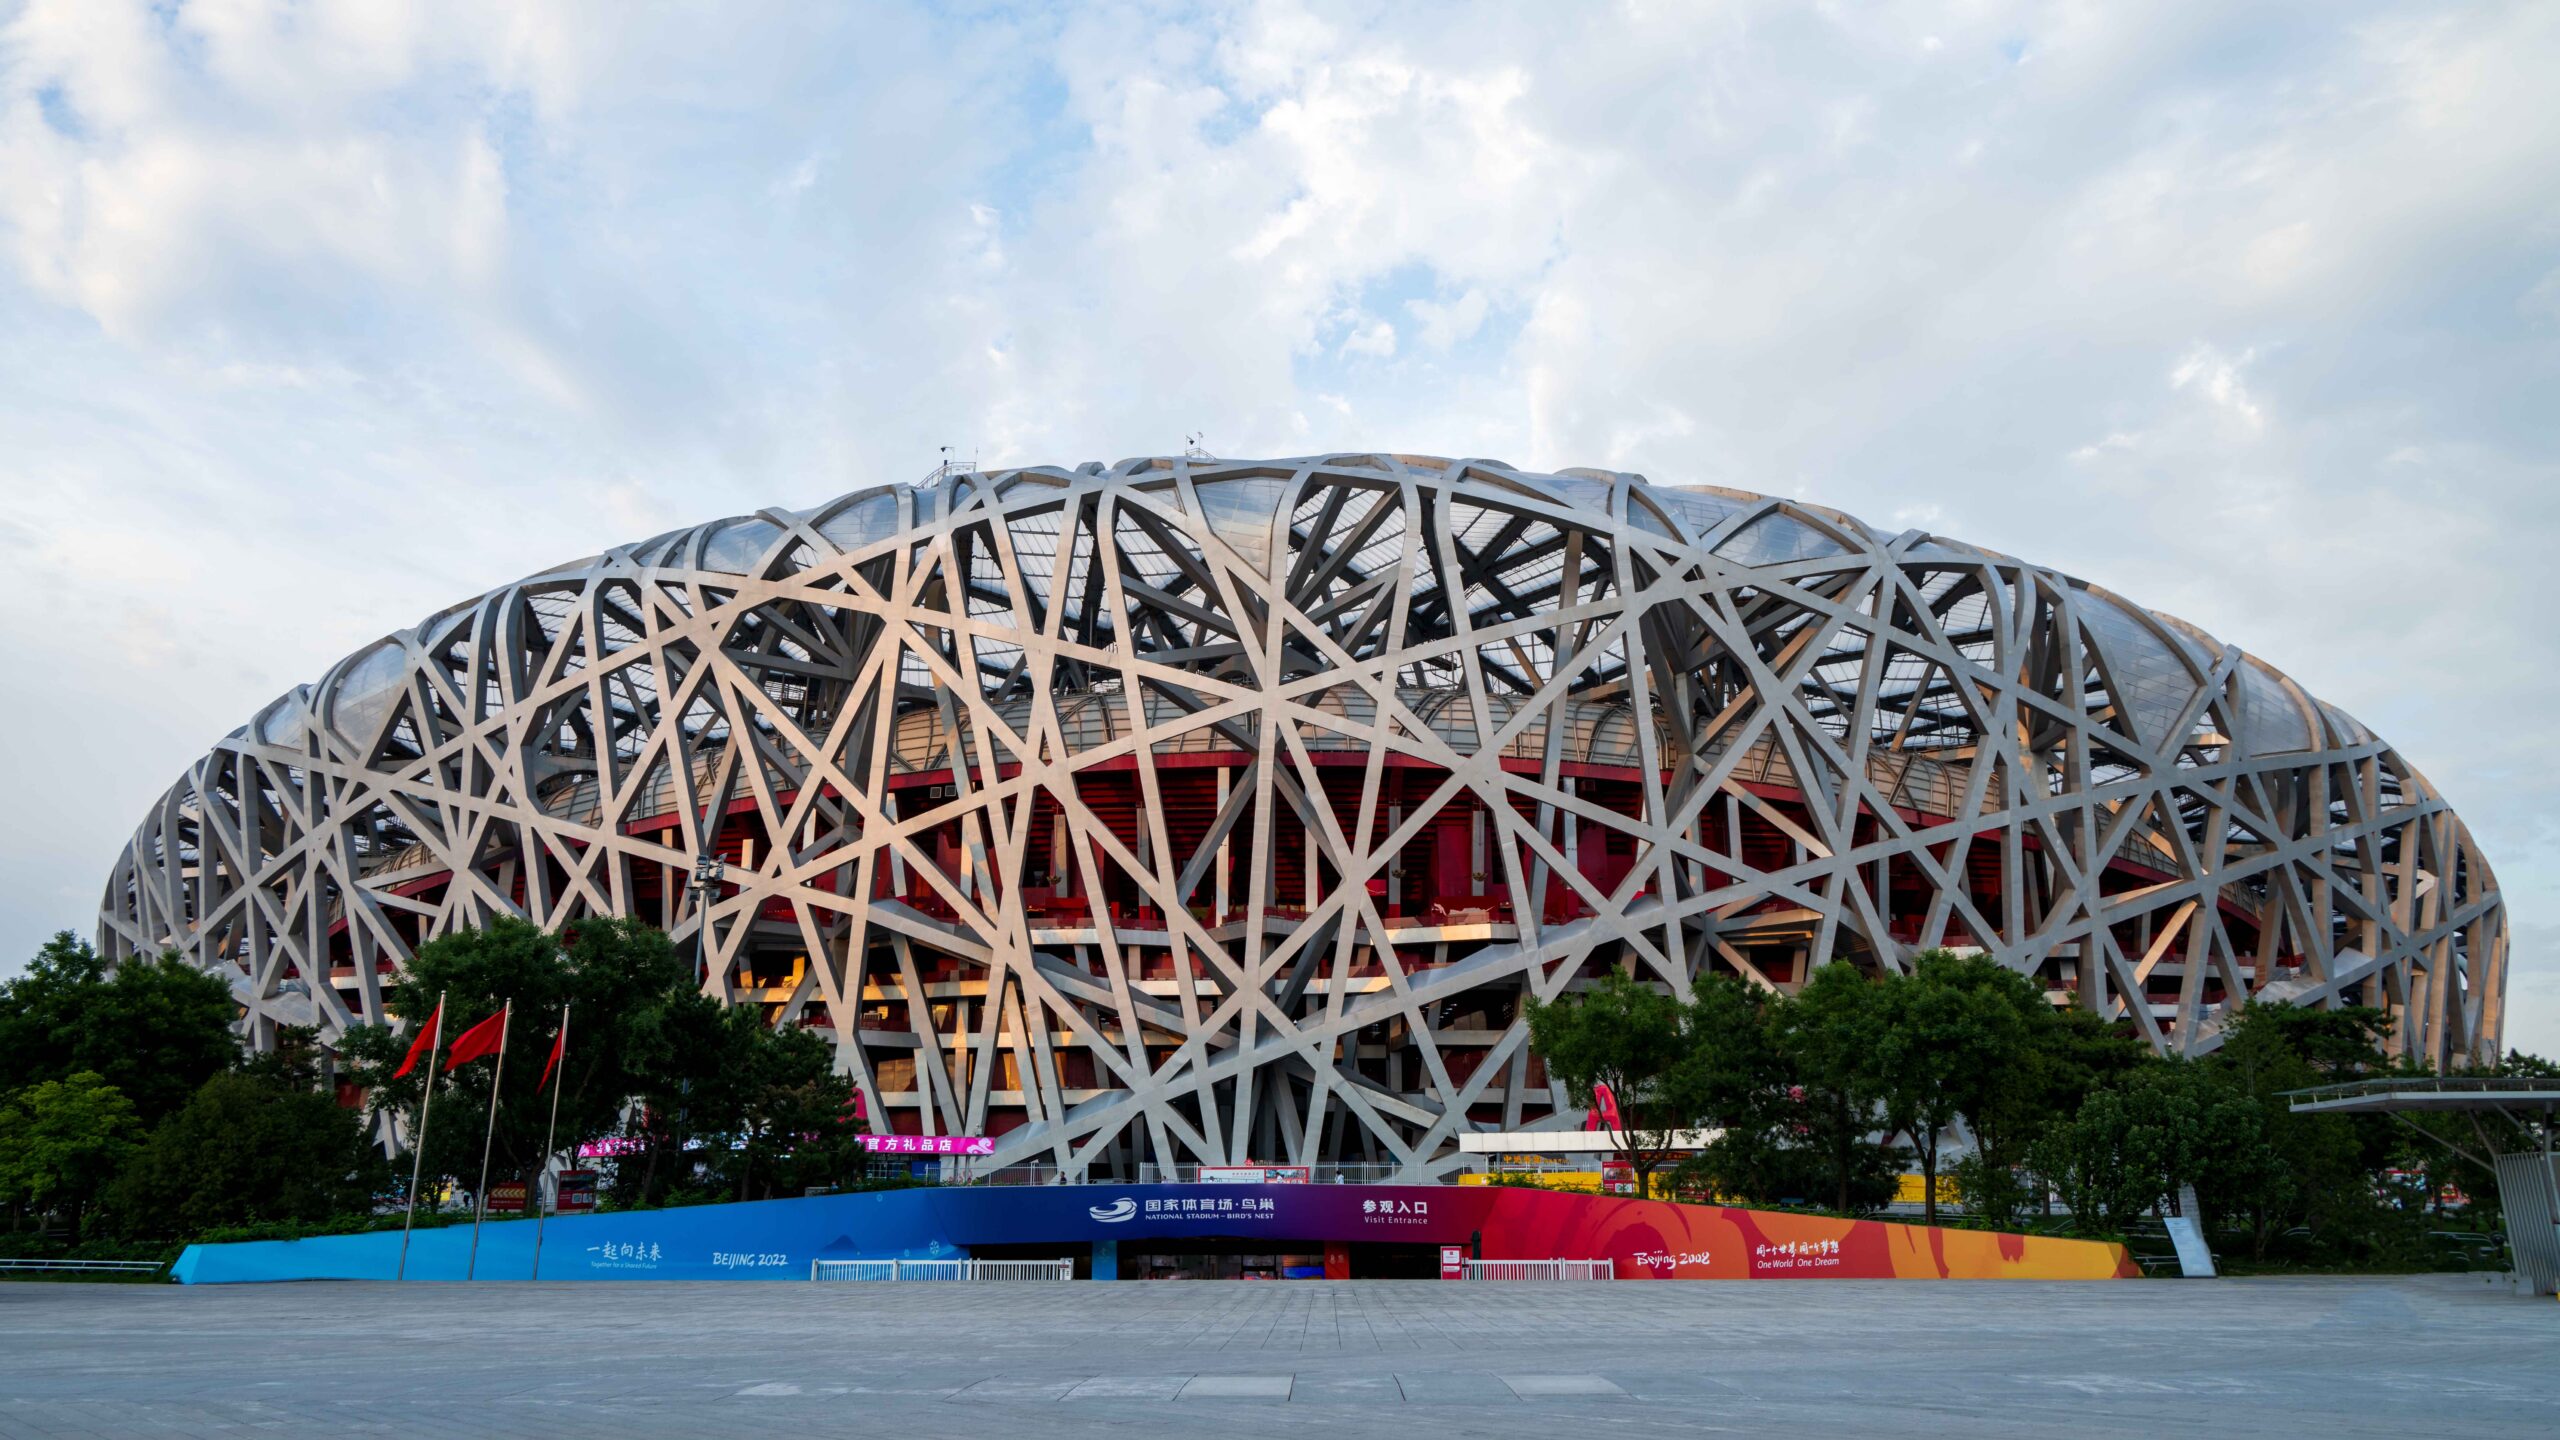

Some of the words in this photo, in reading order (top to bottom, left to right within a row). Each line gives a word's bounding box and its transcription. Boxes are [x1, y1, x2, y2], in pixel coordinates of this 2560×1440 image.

[867, 1137, 952, 1151] 官方礼品店
[1363, 1199, 1427, 1214] 参观入口
[1364, 1215, 1385, 1224] Visit
[1388, 1216, 1428, 1225] Entrance
[586, 1240, 662, 1261] 一起向未来
[712, 1252, 755, 1270] BEIJING
[758, 1253, 789, 1266] 2022
[1632, 1250, 1676, 1269] Beijing
[1678, 1251, 1710, 1265] 2008
[1757, 1260, 1772, 1269] One
[1772, 1259, 1794, 1268] World
[1797, 1258, 1812, 1267] One
[1814, 1257, 1840, 1266] Dream
